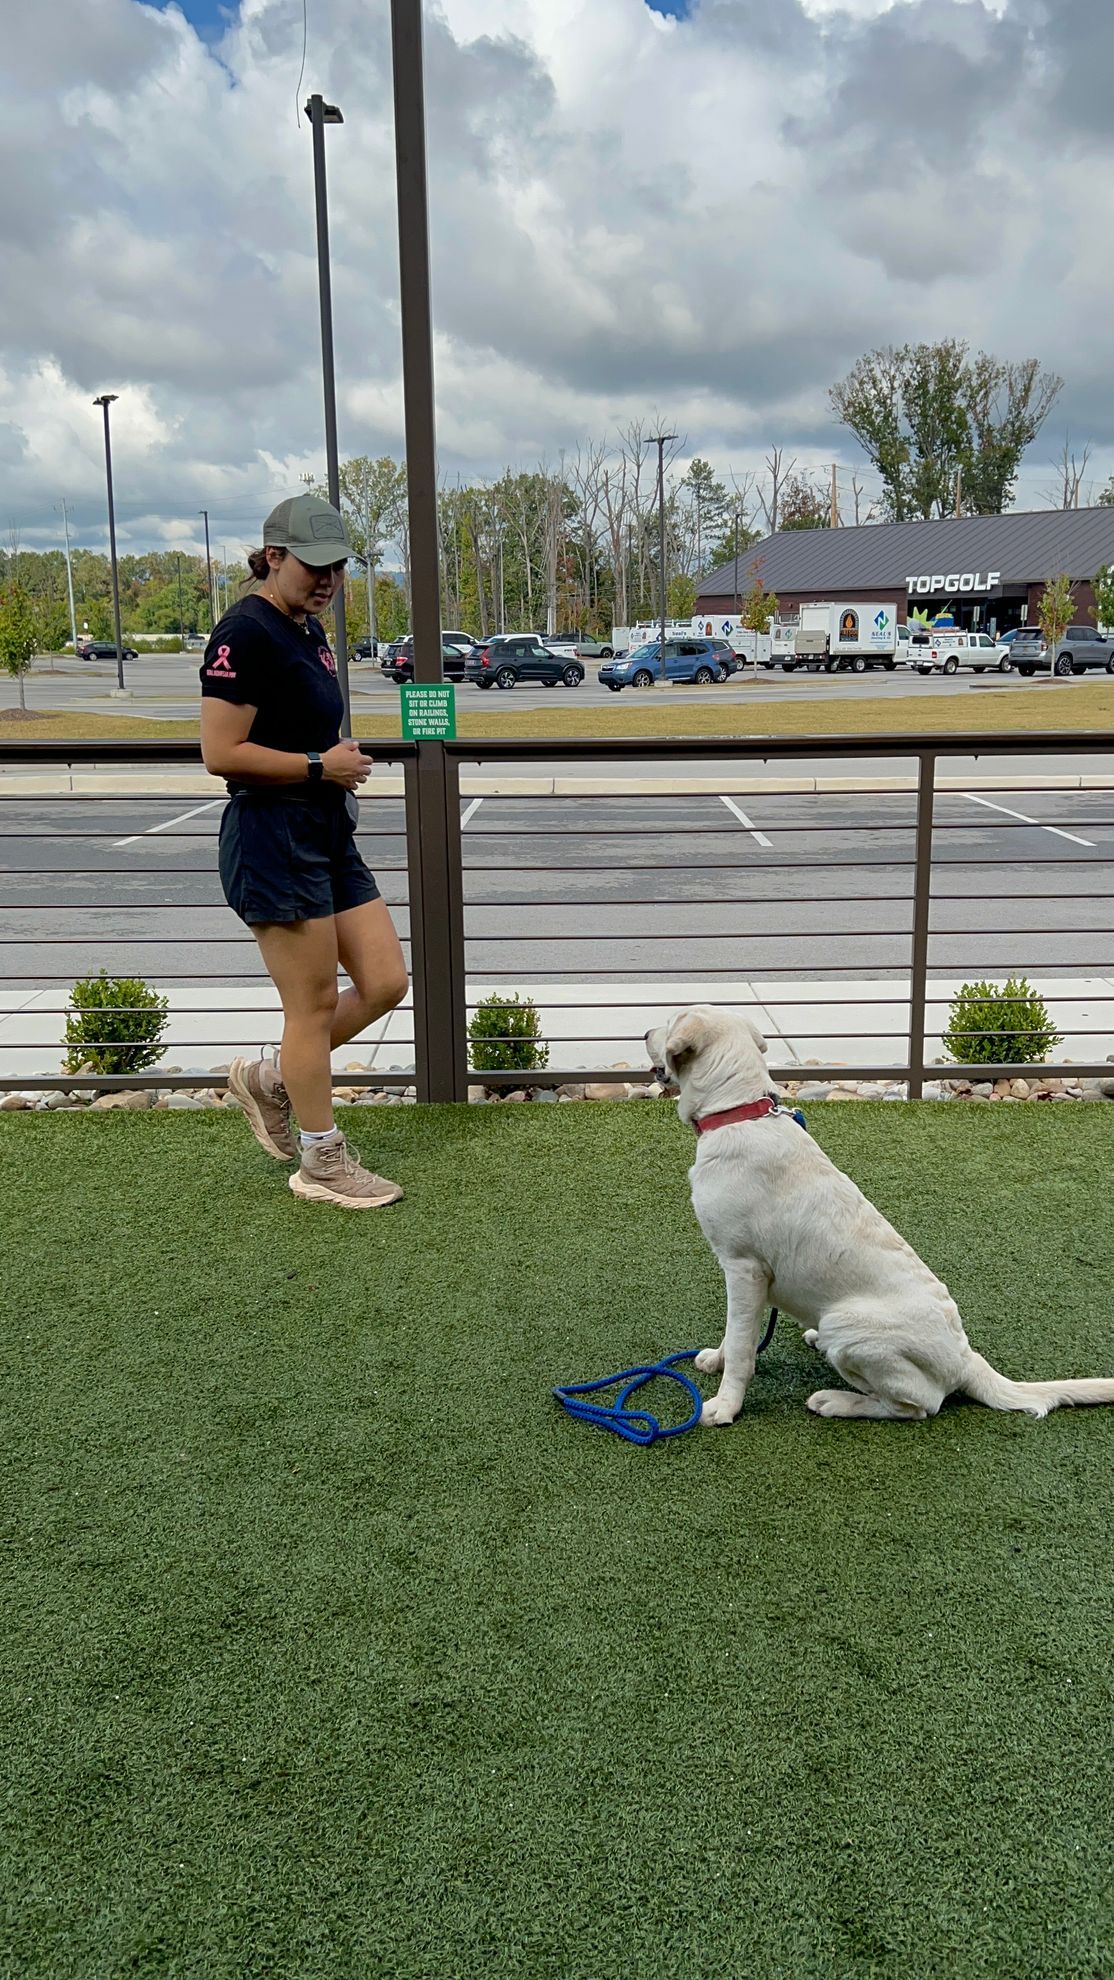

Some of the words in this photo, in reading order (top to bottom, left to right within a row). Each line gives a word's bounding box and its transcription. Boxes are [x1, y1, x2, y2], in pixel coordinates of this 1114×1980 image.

[905, 572, 1001, 594] TOPGOLF
[419, 699, 428, 707] OR
[429, 699, 447, 707] CLIMB
[408, 709, 418, 717] ON
[419, 709, 448, 717] RAILINGS,
[408, 718, 427, 726] STONE
[428, 718, 450, 726] WALLS,
